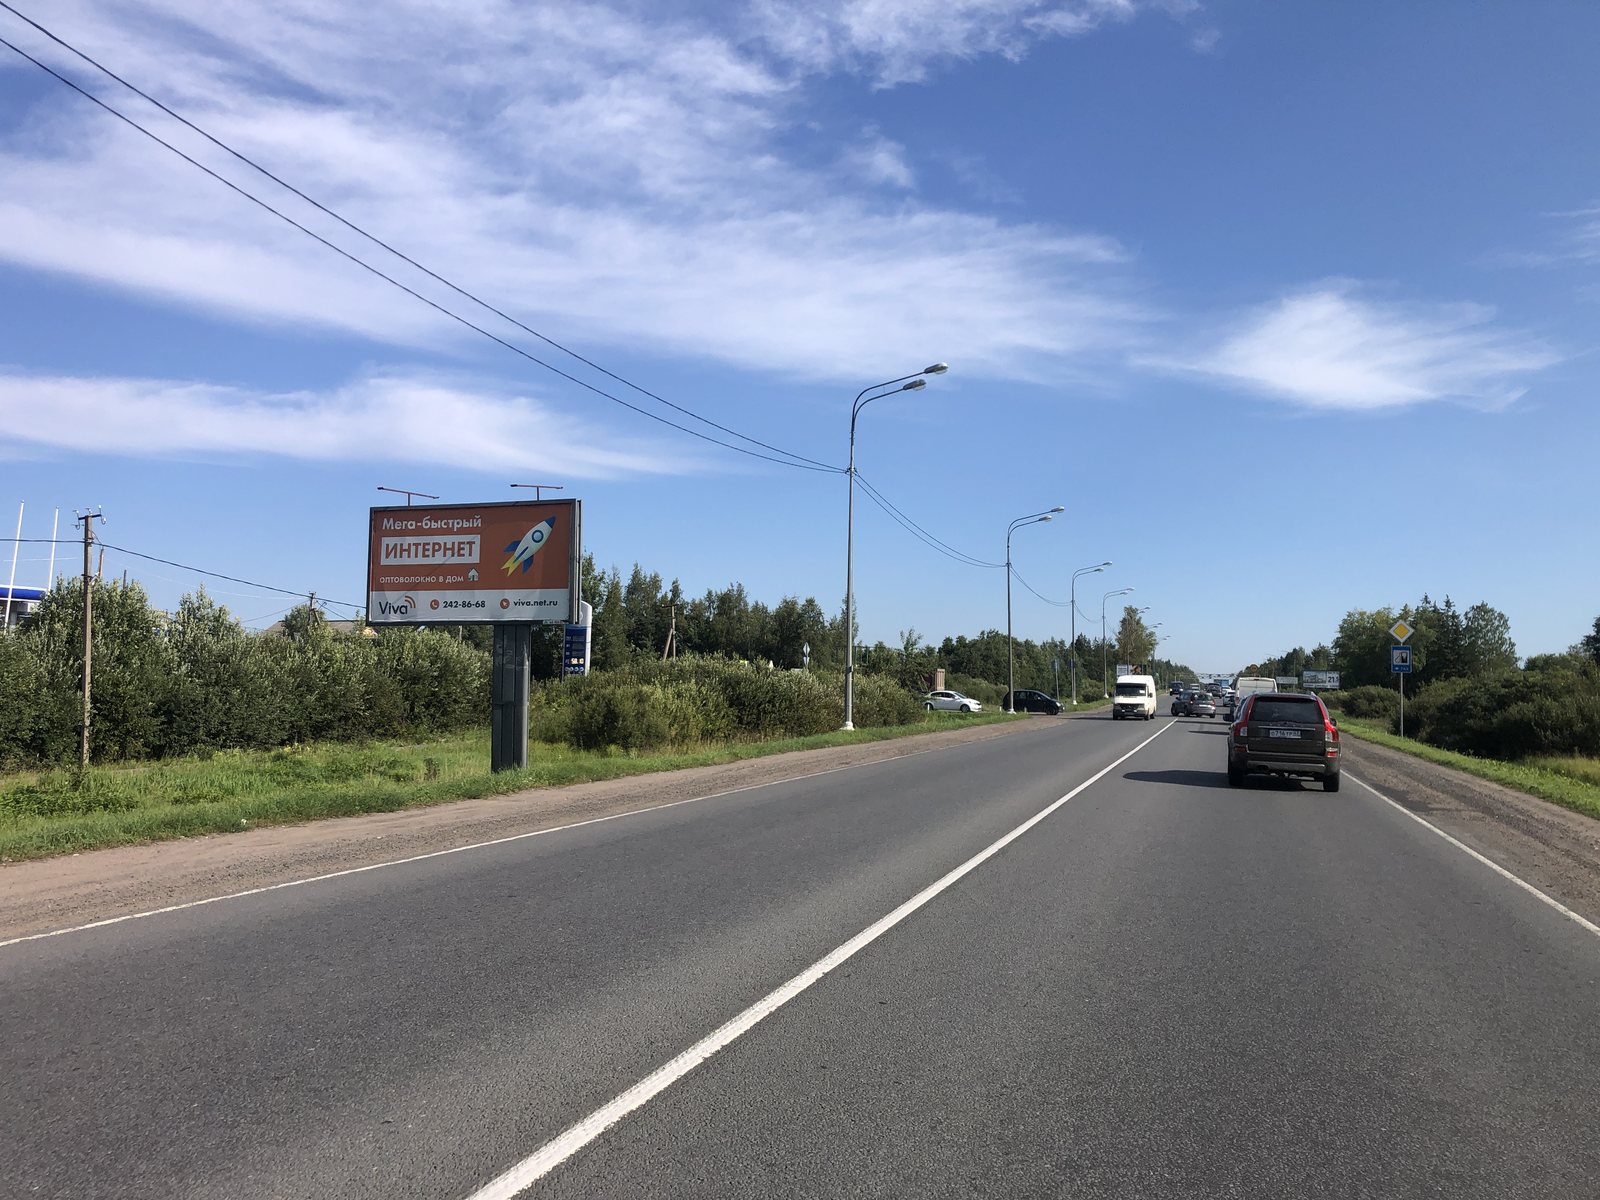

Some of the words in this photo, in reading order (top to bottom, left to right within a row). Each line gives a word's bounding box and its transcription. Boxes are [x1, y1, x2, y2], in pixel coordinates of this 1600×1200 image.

[382, 515, 482, 531] Мега-быстрый
[385, 541, 476, 559] ИНТЕРНЕТ
[379, 575, 437, 583] оптоволокно
[445, 575, 464, 583] дом
[379, 601, 408, 615] Viva
[442, 600, 486, 608] 242-86-68
[513, 599, 558, 607] viva.net.ru
